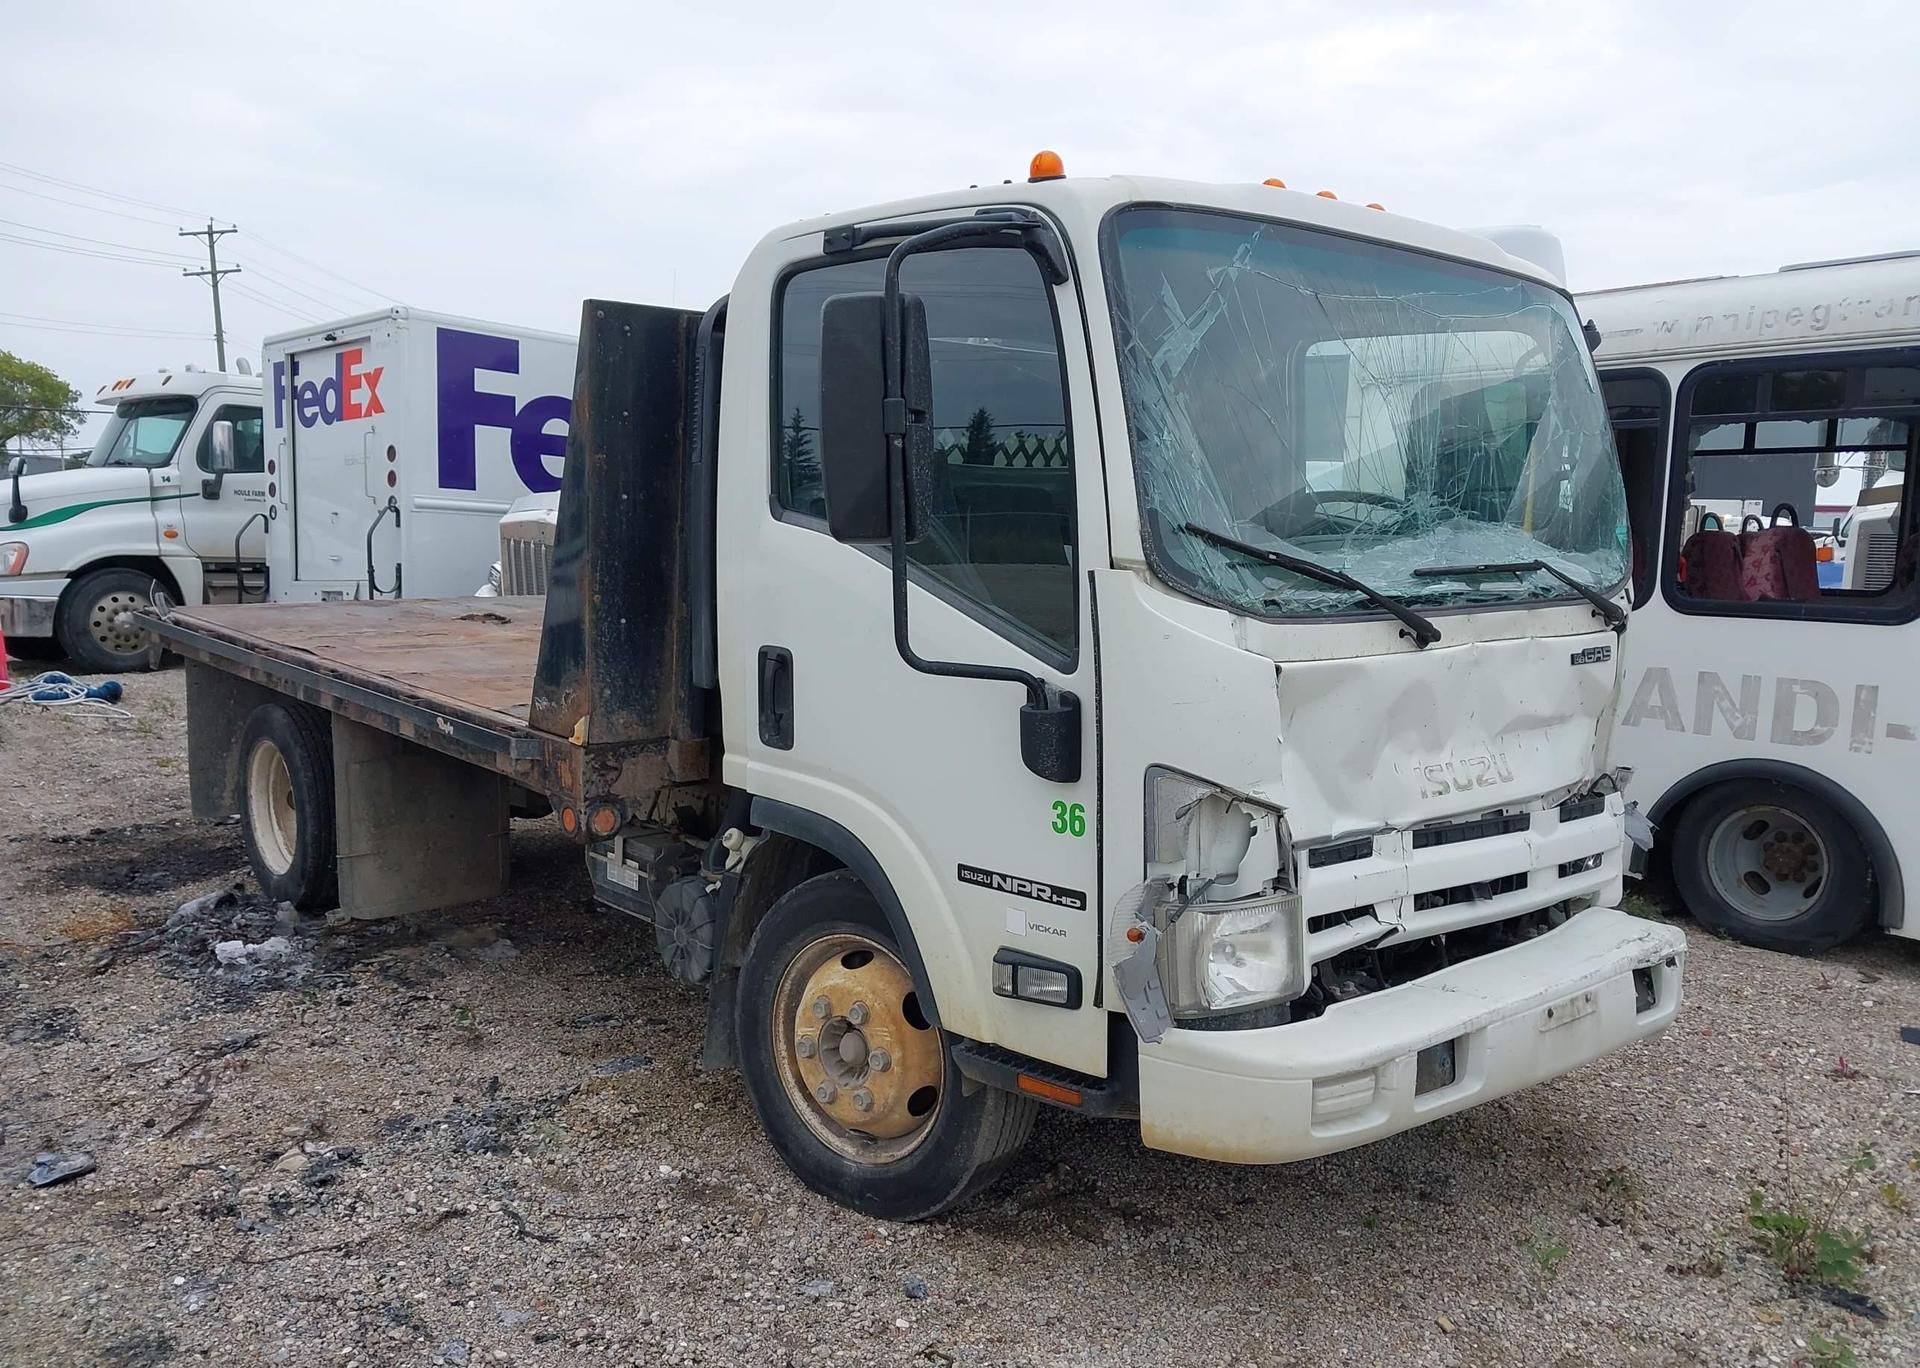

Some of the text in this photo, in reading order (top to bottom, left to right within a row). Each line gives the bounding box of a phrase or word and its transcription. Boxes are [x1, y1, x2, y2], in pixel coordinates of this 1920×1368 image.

[273, 348, 385, 429] FedEx
[161, 475, 171, 483] 14
[1585, 646, 1611, 663] GAS
[1414, 753, 1514, 799] ISUZU
[1052, 800, 1086, 837] 36
[961, 868, 1081, 908] ISUZU NPR HD
[1028, 921, 1067, 938] VICKAR
